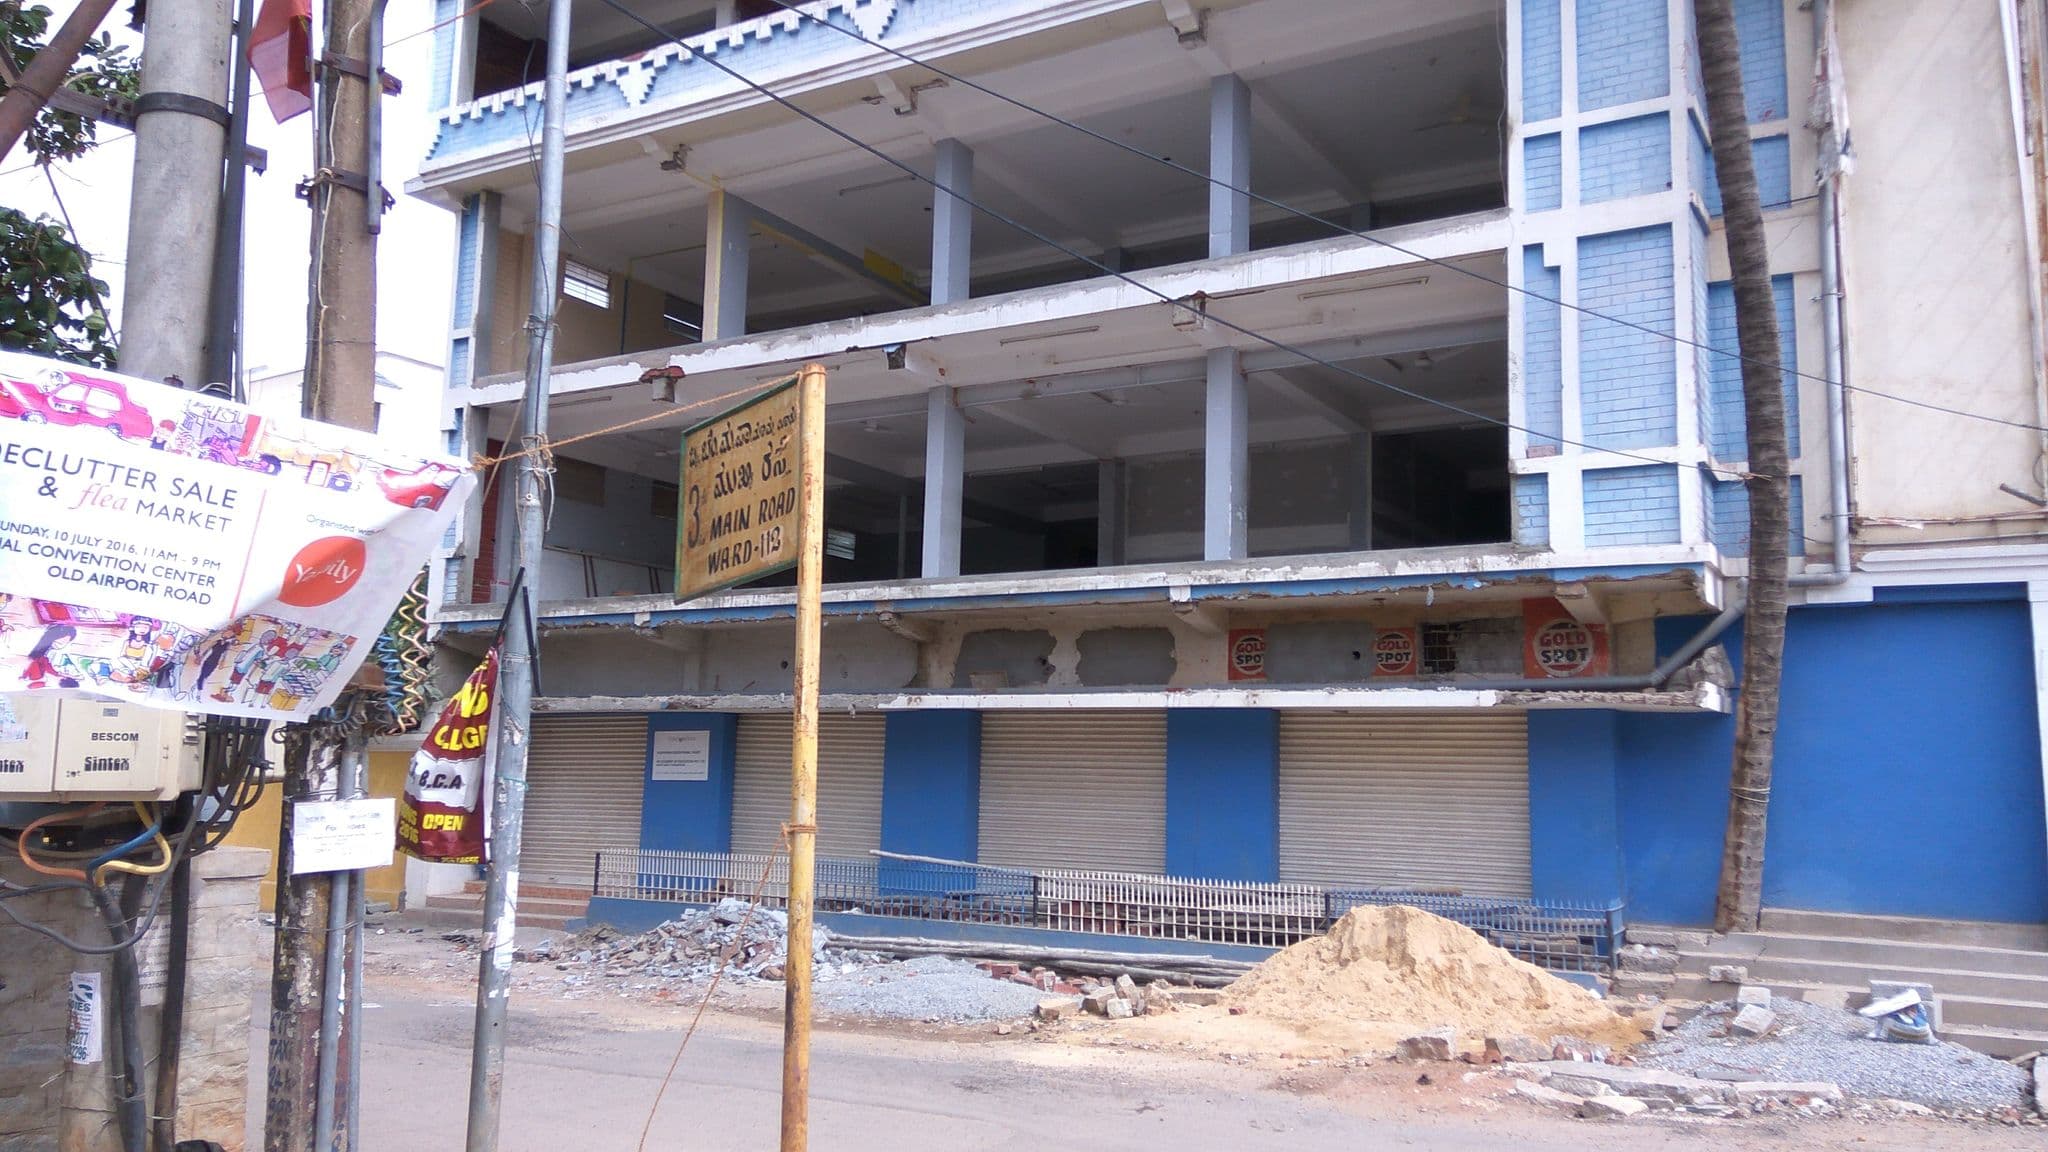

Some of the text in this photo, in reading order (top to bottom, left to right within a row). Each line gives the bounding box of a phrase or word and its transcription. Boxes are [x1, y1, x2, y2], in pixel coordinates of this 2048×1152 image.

[0, 443, 238, 509] ECLUTTER SALE
[38, 476, 233, 532] & flea MARKET
[710, 504, 751, 541] MAIN
[759, 487, 796, 525] ROAD
[0, 520, 50, 539] UNDAY,
[54, 530, 69, 541] 10
[70, 533, 103, 547] JULY
[191, 556, 199, 566] 9
[202, 558, 221, 571] PM
[28, 543, 147, 574] CONVENTION
[152, 565, 216, 588] CENTER
[47, 565, 212, 605] OLD AIRPORT ROAD
[1376, 640, 1410, 651] GOLD
[1540, 631, 1586, 647] GOLD
[1376, 651, 1411, 663] SPOT
[1541, 648, 1589, 664] SPOT
[91, 732, 140, 742] BESCOM
[0, 756, 130, 774] tex Sintex
[422, 813, 464, 831] OPEN
